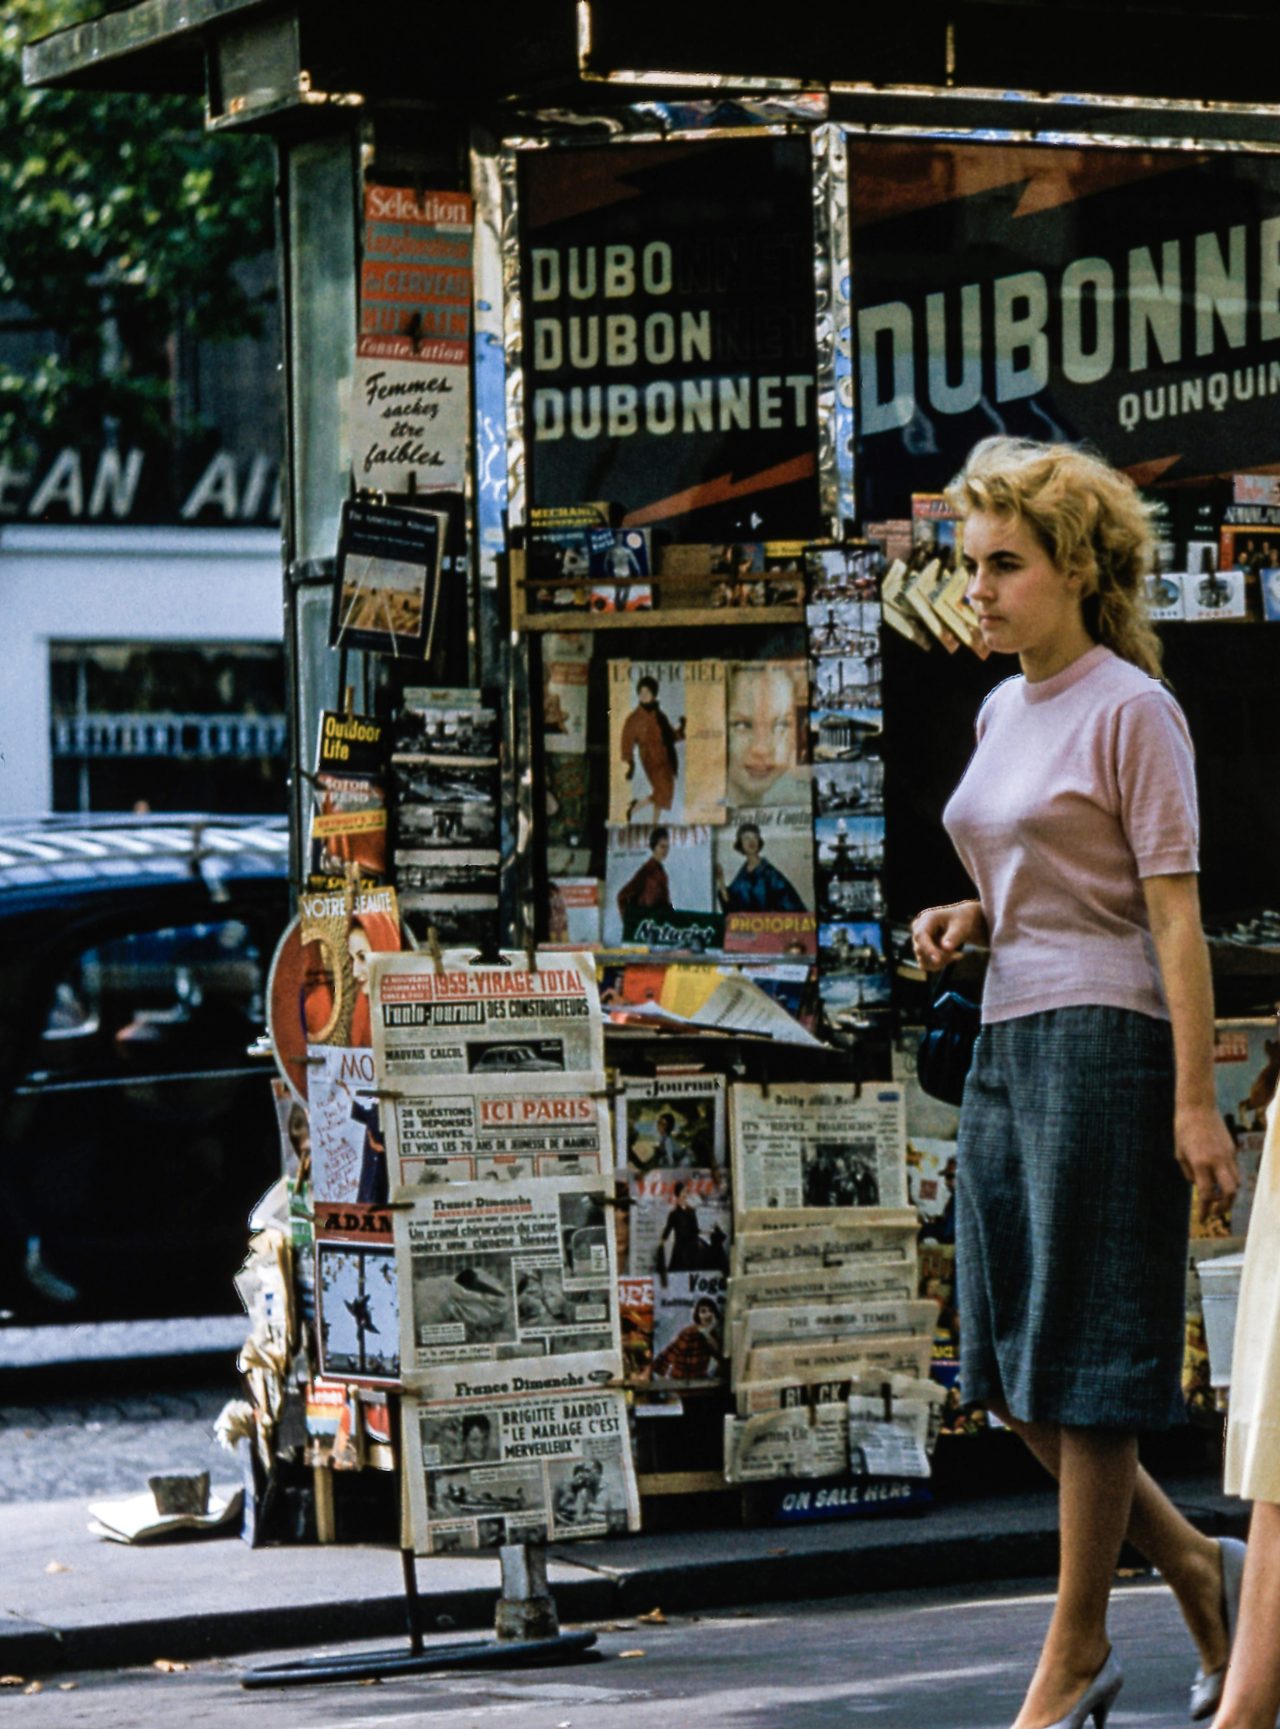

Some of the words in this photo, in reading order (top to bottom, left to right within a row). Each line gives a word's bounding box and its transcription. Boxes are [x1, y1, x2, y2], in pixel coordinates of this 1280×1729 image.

[532, 241, 673, 301] DUBO
[534, 310, 711, 370] DUBON
[366, 371, 453, 405] Femmes
[382, 397, 439, 421] sachez
[535, 375, 814, 441] DUBONNET
[364, 440, 445, 473] faibles
[612, 662, 724, 684] L'OFFICIEL
[325, 718, 381, 742] Outdoor
[323, 738, 349, 760] Life
[303, 896, 346, 918] VOTRE
[540, 969, 586, 992] TOTAL
[509, 998, 589, 1018] CONSTRUCTEURS
[385, 1049, 425, 1061] MAUVAIS
[430, 1047, 463, 1060] CALCUL
[416, 1107, 473, 1117] QUESTIONS
[480, 1099, 514, 1121] ICI
[523, 1099, 591, 1120] PARIS
[402, 1143, 412, 1153] ET
[433, 1198, 473, 1211] France
[476, 1195, 532, 1209] Dimanche
[409, 1228, 425, 1239] Un
[427, 1226, 458, 1241] grand
[461, 1223, 514, 1238] chirurgien
[517, 1222, 531, 1233] du
[788, 1317, 809, 1328] THE
[862, 1313, 897, 1324] TIMES
[455, 1382, 509, 1397] France
[512, 1372, 584, 1391] Dimanche
[502, 1407, 555, 1425] BRIGITTE
[563, 1402, 610, 1420] BARDOT
[531, 1421, 583, 1438] MARIAGE
[588, 1418, 620, 1434] C'EST
[782, 1492, 810, 1511] ON
[814, 1489, 858, 1508] SALE
[864, 1483, 912, 1502] HERE
